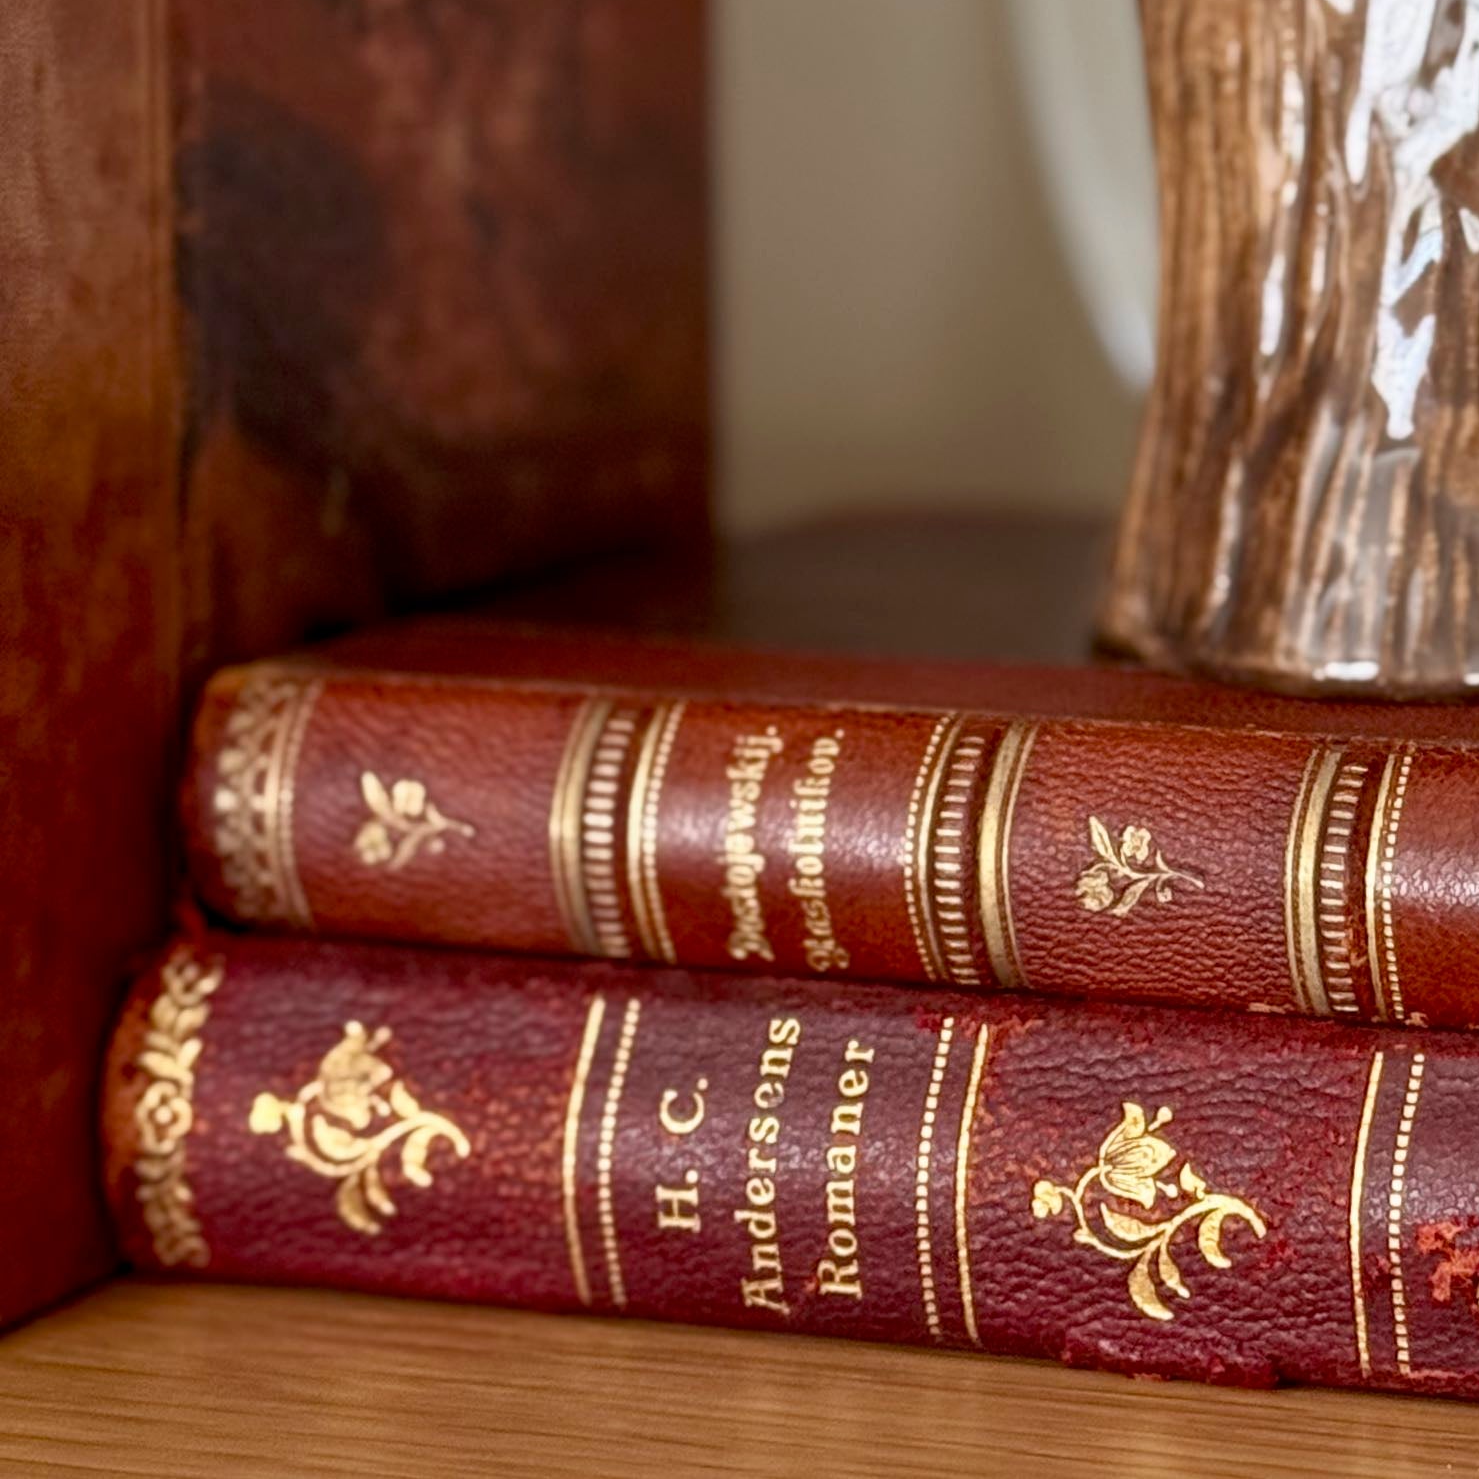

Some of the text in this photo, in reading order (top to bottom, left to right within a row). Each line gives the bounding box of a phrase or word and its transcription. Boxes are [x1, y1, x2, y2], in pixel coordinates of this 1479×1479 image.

[655, 1078, 709, 1233] H. C.
[734, 1017, 800, 1315] Andersens
[816, 1039, 875, 1300] Romaner
